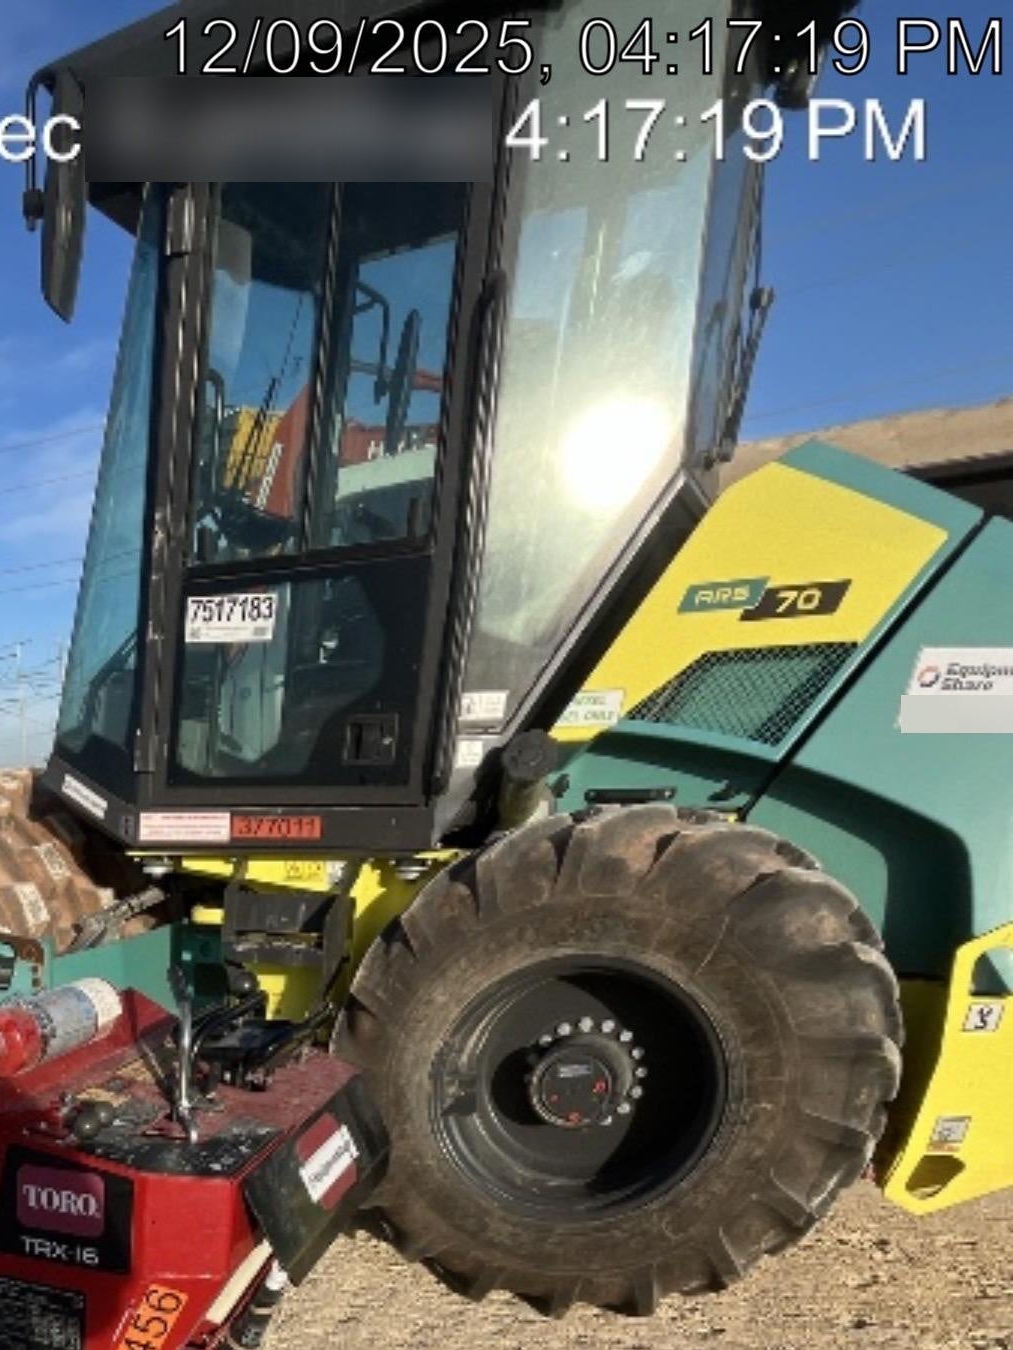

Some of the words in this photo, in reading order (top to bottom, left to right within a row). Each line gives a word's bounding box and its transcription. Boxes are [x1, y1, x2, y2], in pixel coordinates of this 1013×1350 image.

[190, 596, 273, 622] 7517183
[775, 588, 822, 613] 70
[940, 677, 994, 691] Share
[237, 817, 315, 838] 377011
[22, 1184, 97, 1217] TORO
[20, 1235, 100, 1265] TRX-16
